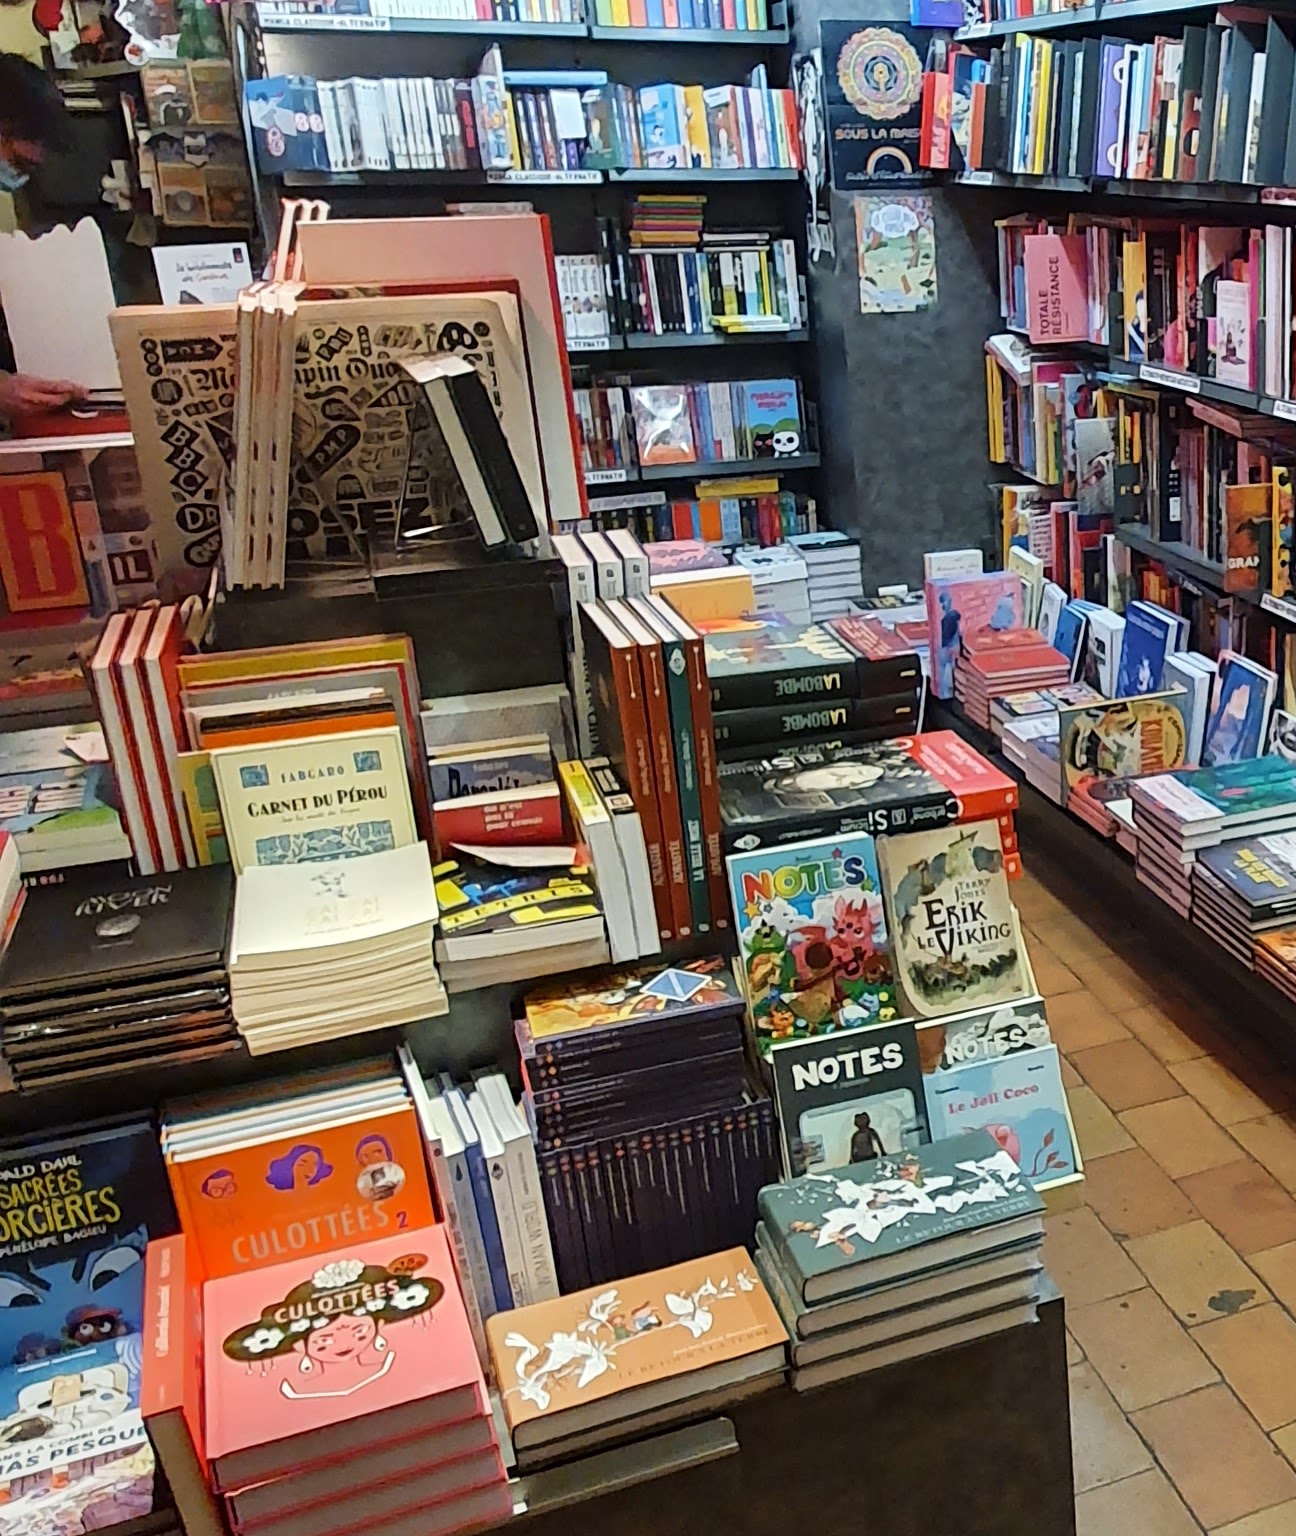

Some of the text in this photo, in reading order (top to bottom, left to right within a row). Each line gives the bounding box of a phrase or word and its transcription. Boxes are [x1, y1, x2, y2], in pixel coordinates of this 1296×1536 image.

[247, 785, 388, 818] CARNET DU PÉROU
[742, 854, 866, 905] NOTES
[791, 1042, 905, 1092] NOTES
[945, 1028, 1028, 1065] NOTES
[947, 1101, 965, 1115] Le
[1003, 1083, 1040, 1101] Coco
[231, 1199, 410, 1267] CULOTTÉES 2
[273, 1276, 401, 1326] CULOTTÉES
